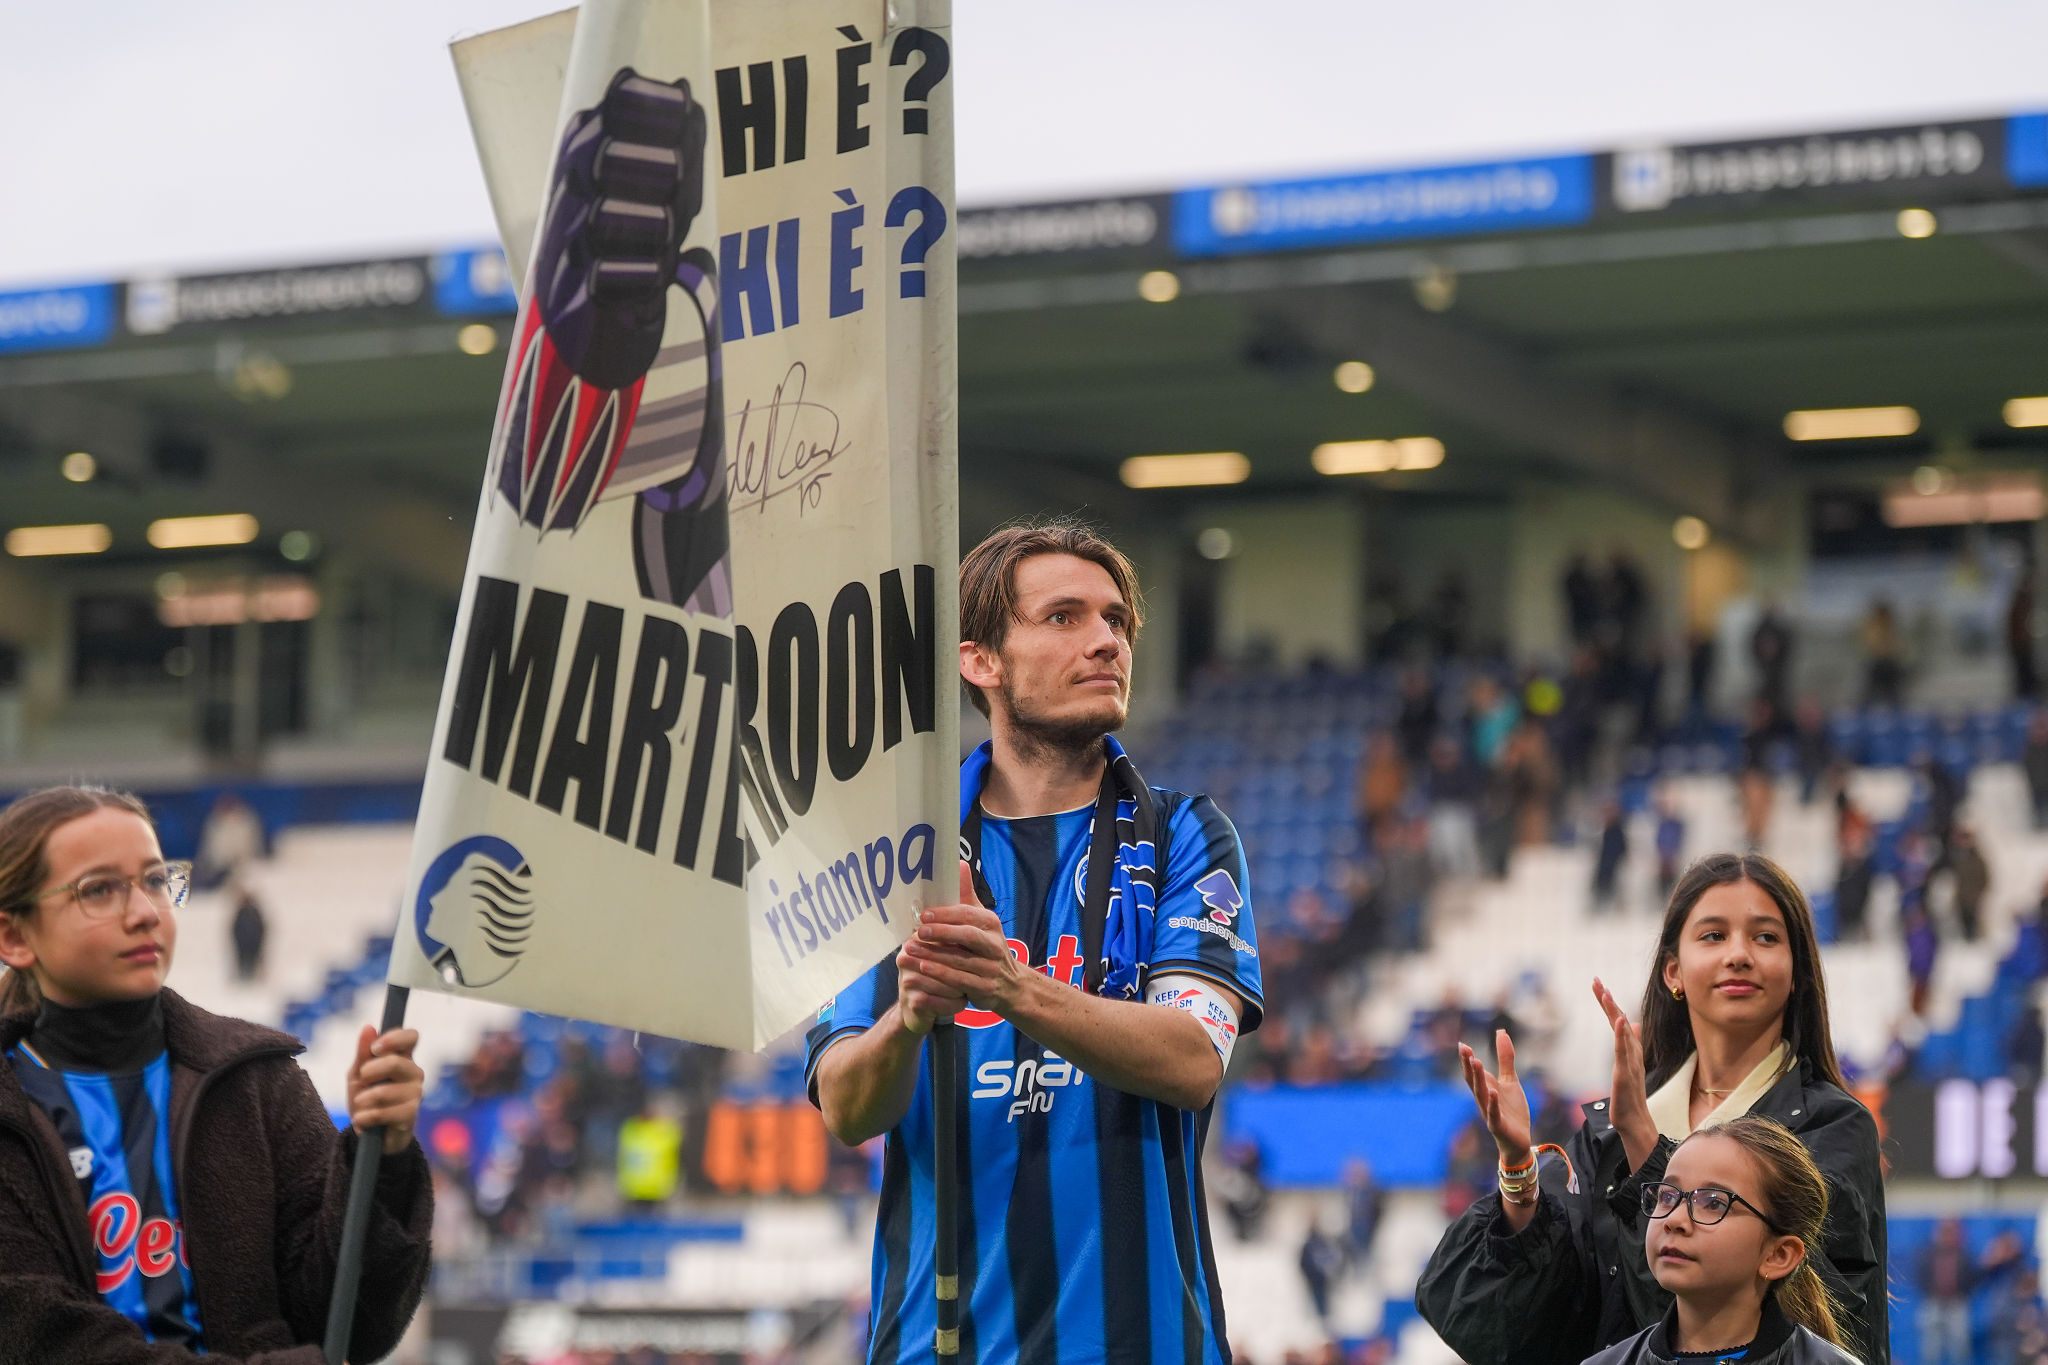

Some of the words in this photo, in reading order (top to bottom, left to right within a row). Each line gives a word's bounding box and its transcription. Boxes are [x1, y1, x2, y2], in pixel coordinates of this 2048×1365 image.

[715, 54, 808, 178] HI
[720, 217, 799, 343] HI
[1168, 916, 1257, 958] zondacrypto
[1155, 990, 1180, 1004] KEEP
[1162, 999, 1193, 1009] CISM
[1208, 1001, 1229, 1022] KEEP
